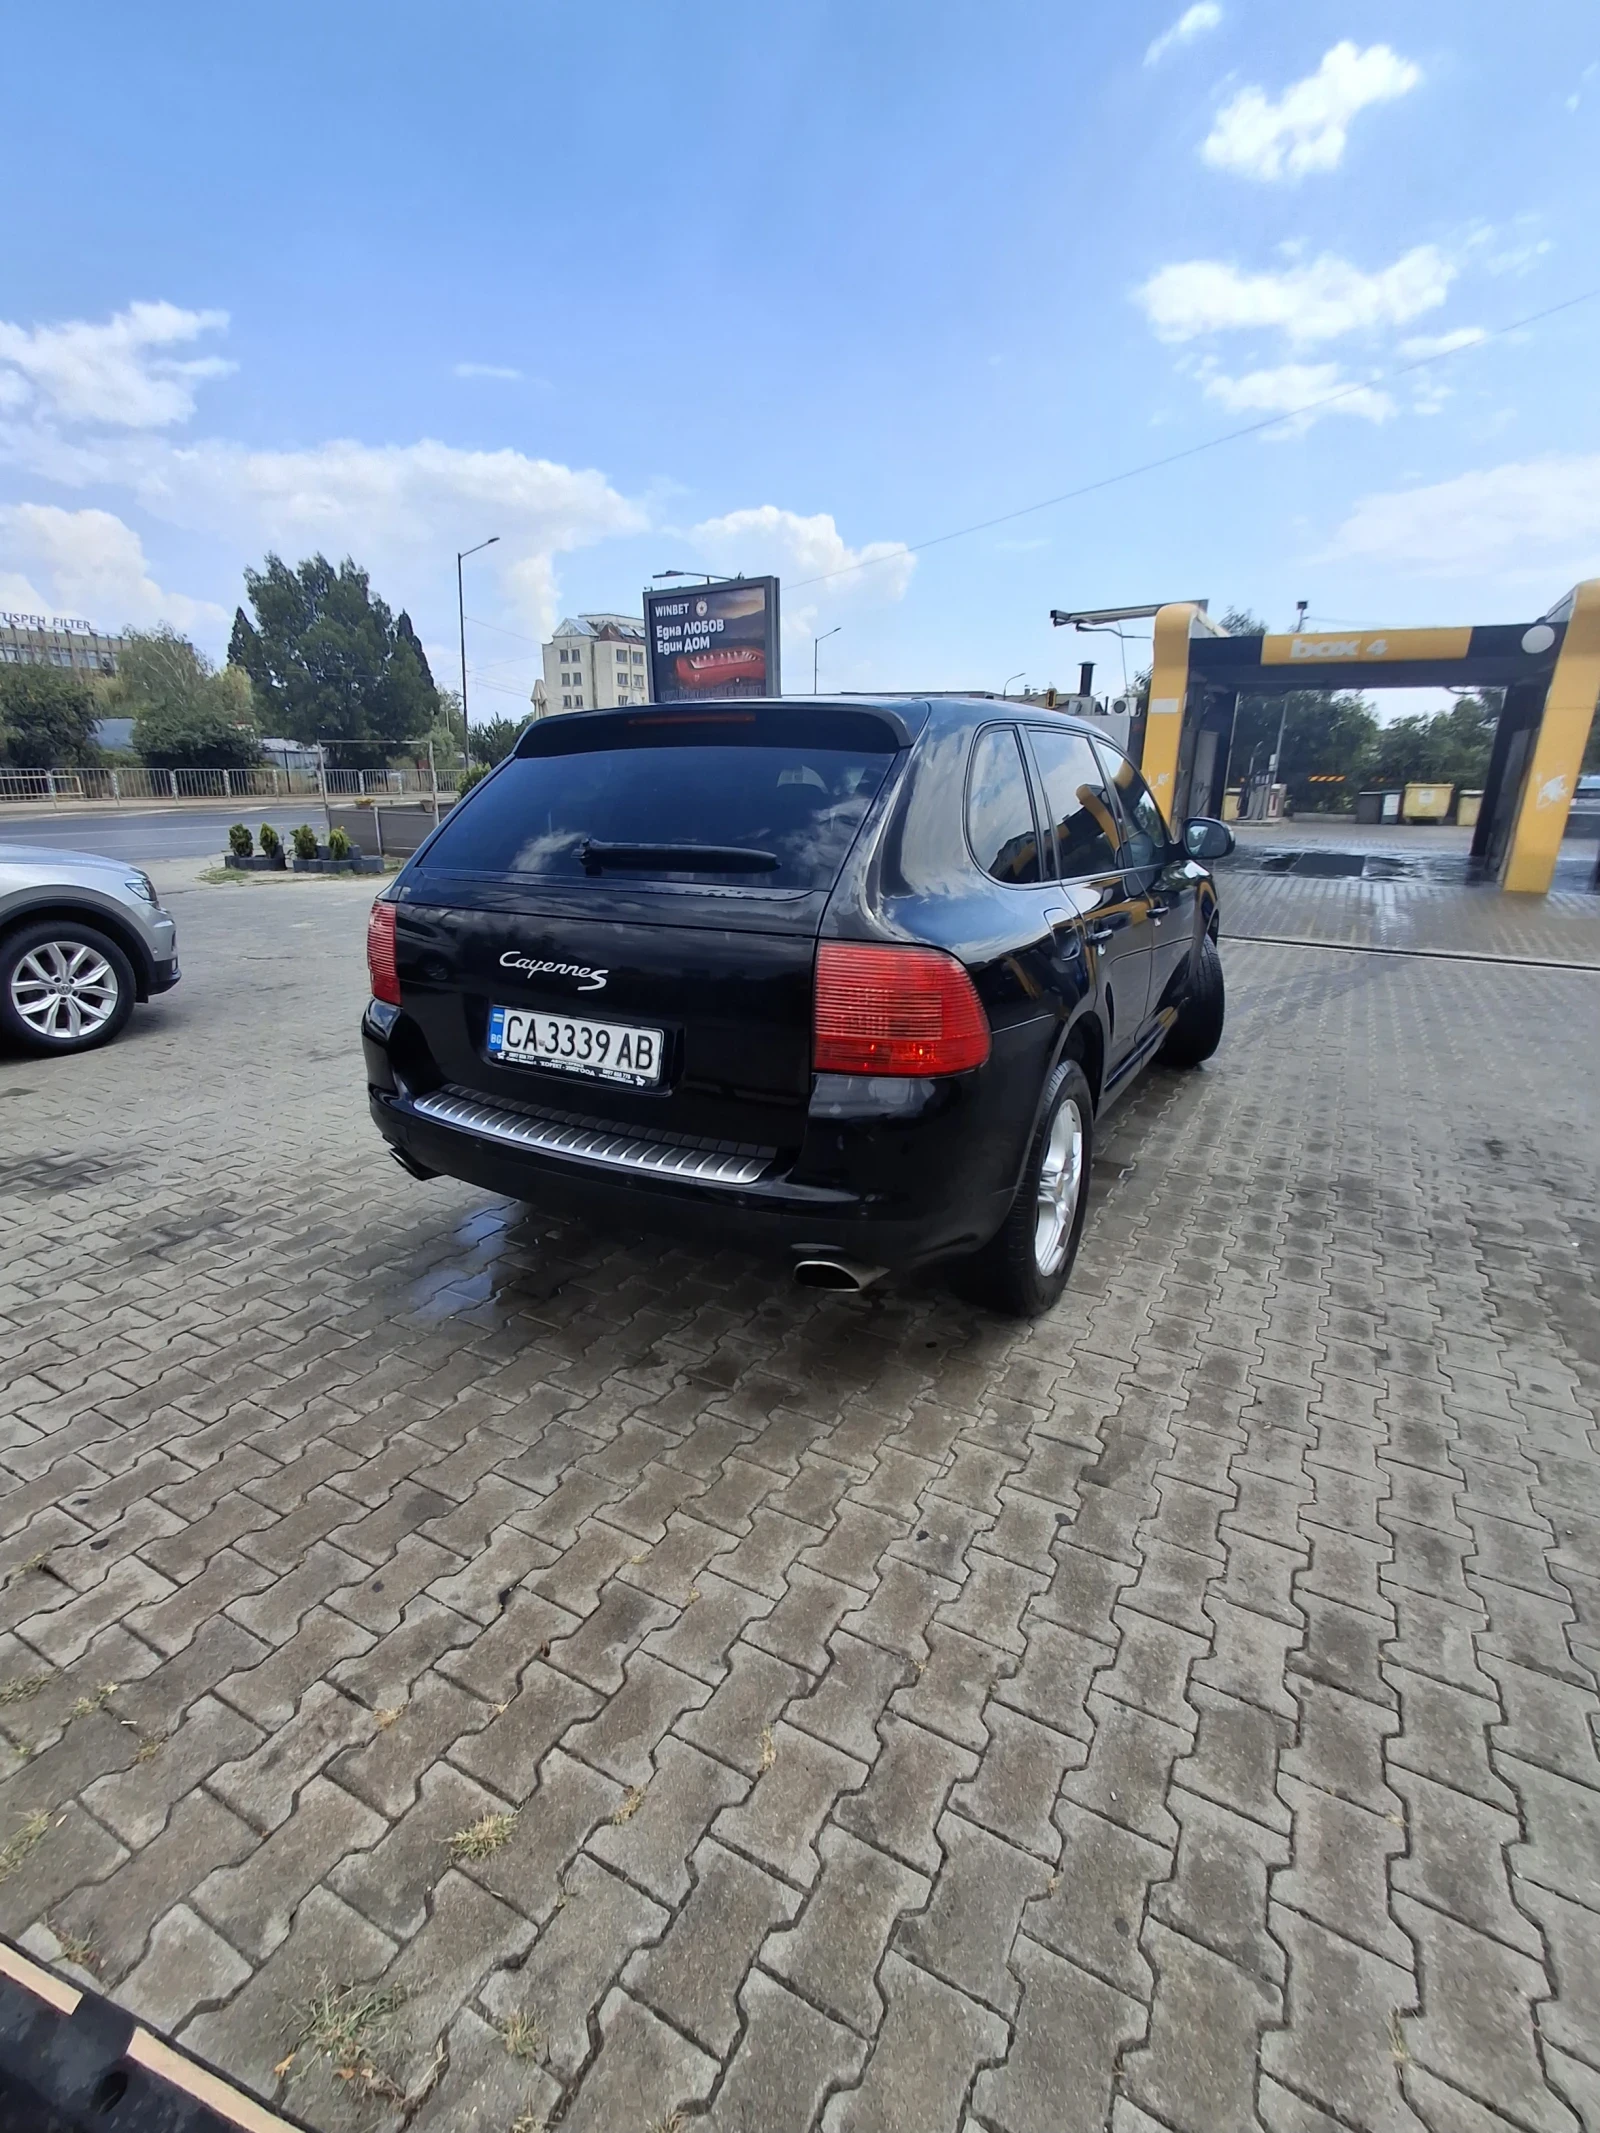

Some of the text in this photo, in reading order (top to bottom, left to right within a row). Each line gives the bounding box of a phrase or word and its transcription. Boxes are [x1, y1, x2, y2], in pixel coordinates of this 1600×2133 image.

[655, 603, 689, 617] WINBET
[53, 617, 91, 629] FILTER
[683, 619, 725, 636] ЛЮБОВ
[684, 636, 710, 653] ДОМ
[1290, 639, 1389, 658] box 4
[490, 1033, 502, 1044] BG
